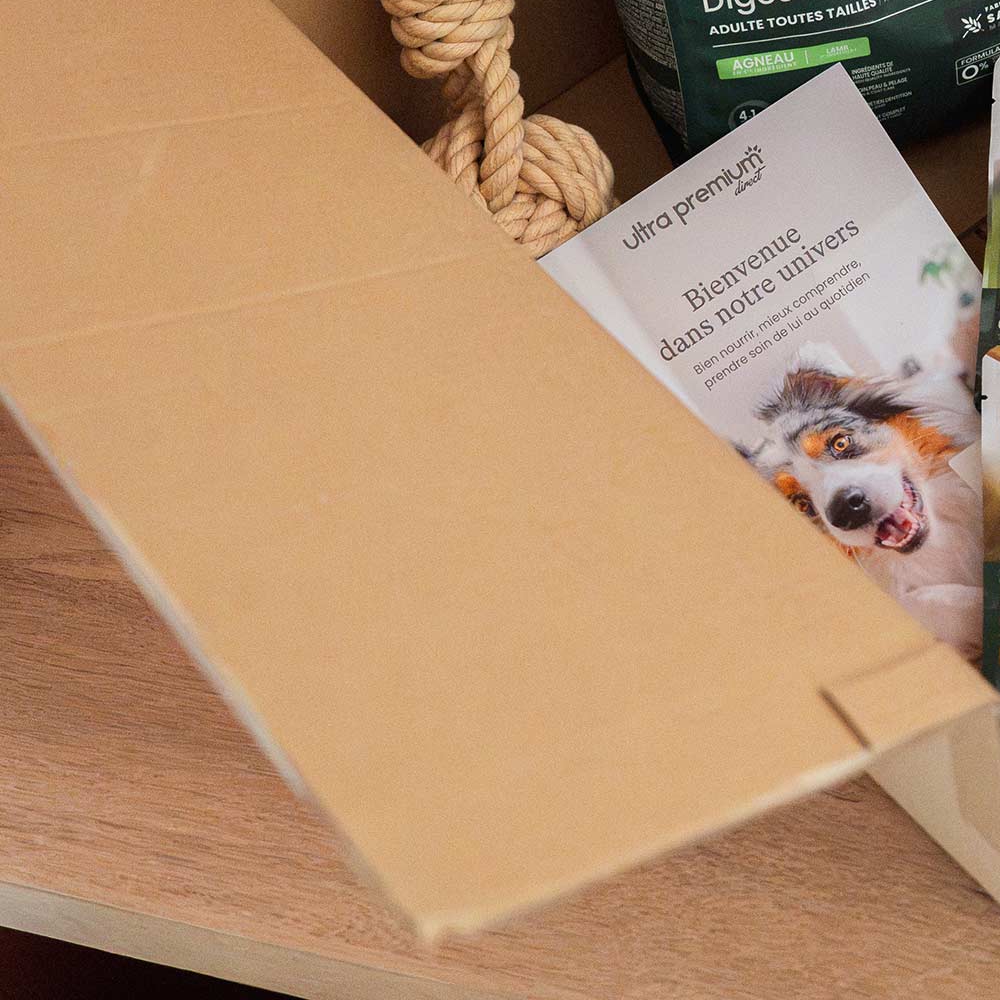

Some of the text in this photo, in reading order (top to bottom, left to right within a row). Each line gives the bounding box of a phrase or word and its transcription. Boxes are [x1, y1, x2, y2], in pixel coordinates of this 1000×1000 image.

[709, 19, 765, 36] ADULTE
[767, 10, 823, 28] TOUTES
[732, 51, 794, 71] AGNEAU
[622, 150, 764, 250] ultra premium
[734, 165, 766, 196] direct
[659, 218, 860, 362] dans notre univers
[681, 227, 801, 312] Bienvenue
[693, 259, 862, 375] Bien nourrir, mieux comprendre,
[704, 271, 871, 392] prendre soin de lui au quotidien
